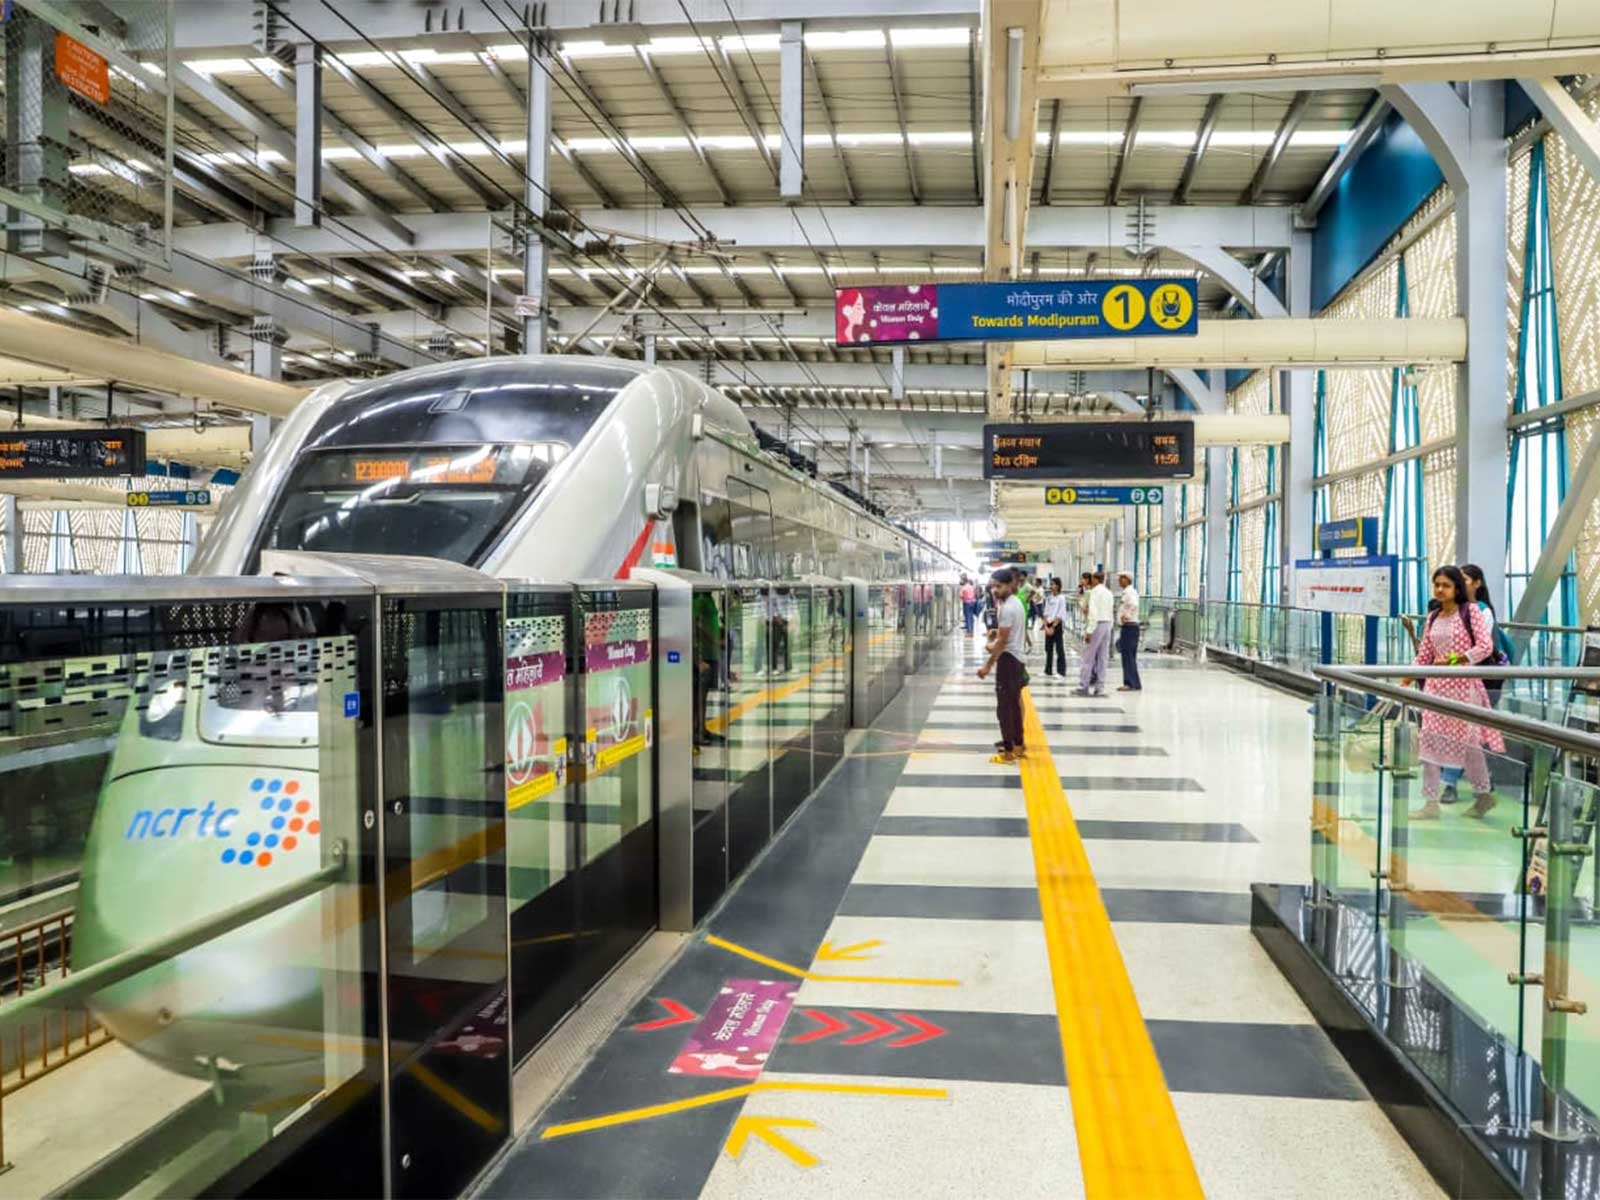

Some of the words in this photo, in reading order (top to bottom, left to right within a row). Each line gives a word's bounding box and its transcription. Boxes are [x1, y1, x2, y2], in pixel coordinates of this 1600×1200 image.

[1006, 290, 1054, 310] मोदीपुरम
[1057, 290, 1074, 305] की
[1077, 290, 1098, 305] ओर
[1114, 291, 1132, 324] 1
[971, 315, 1024, 328] Towards
[1027, 313, 1099, 329] Modipuram
[125, 799, 240, 840] ncrtc
